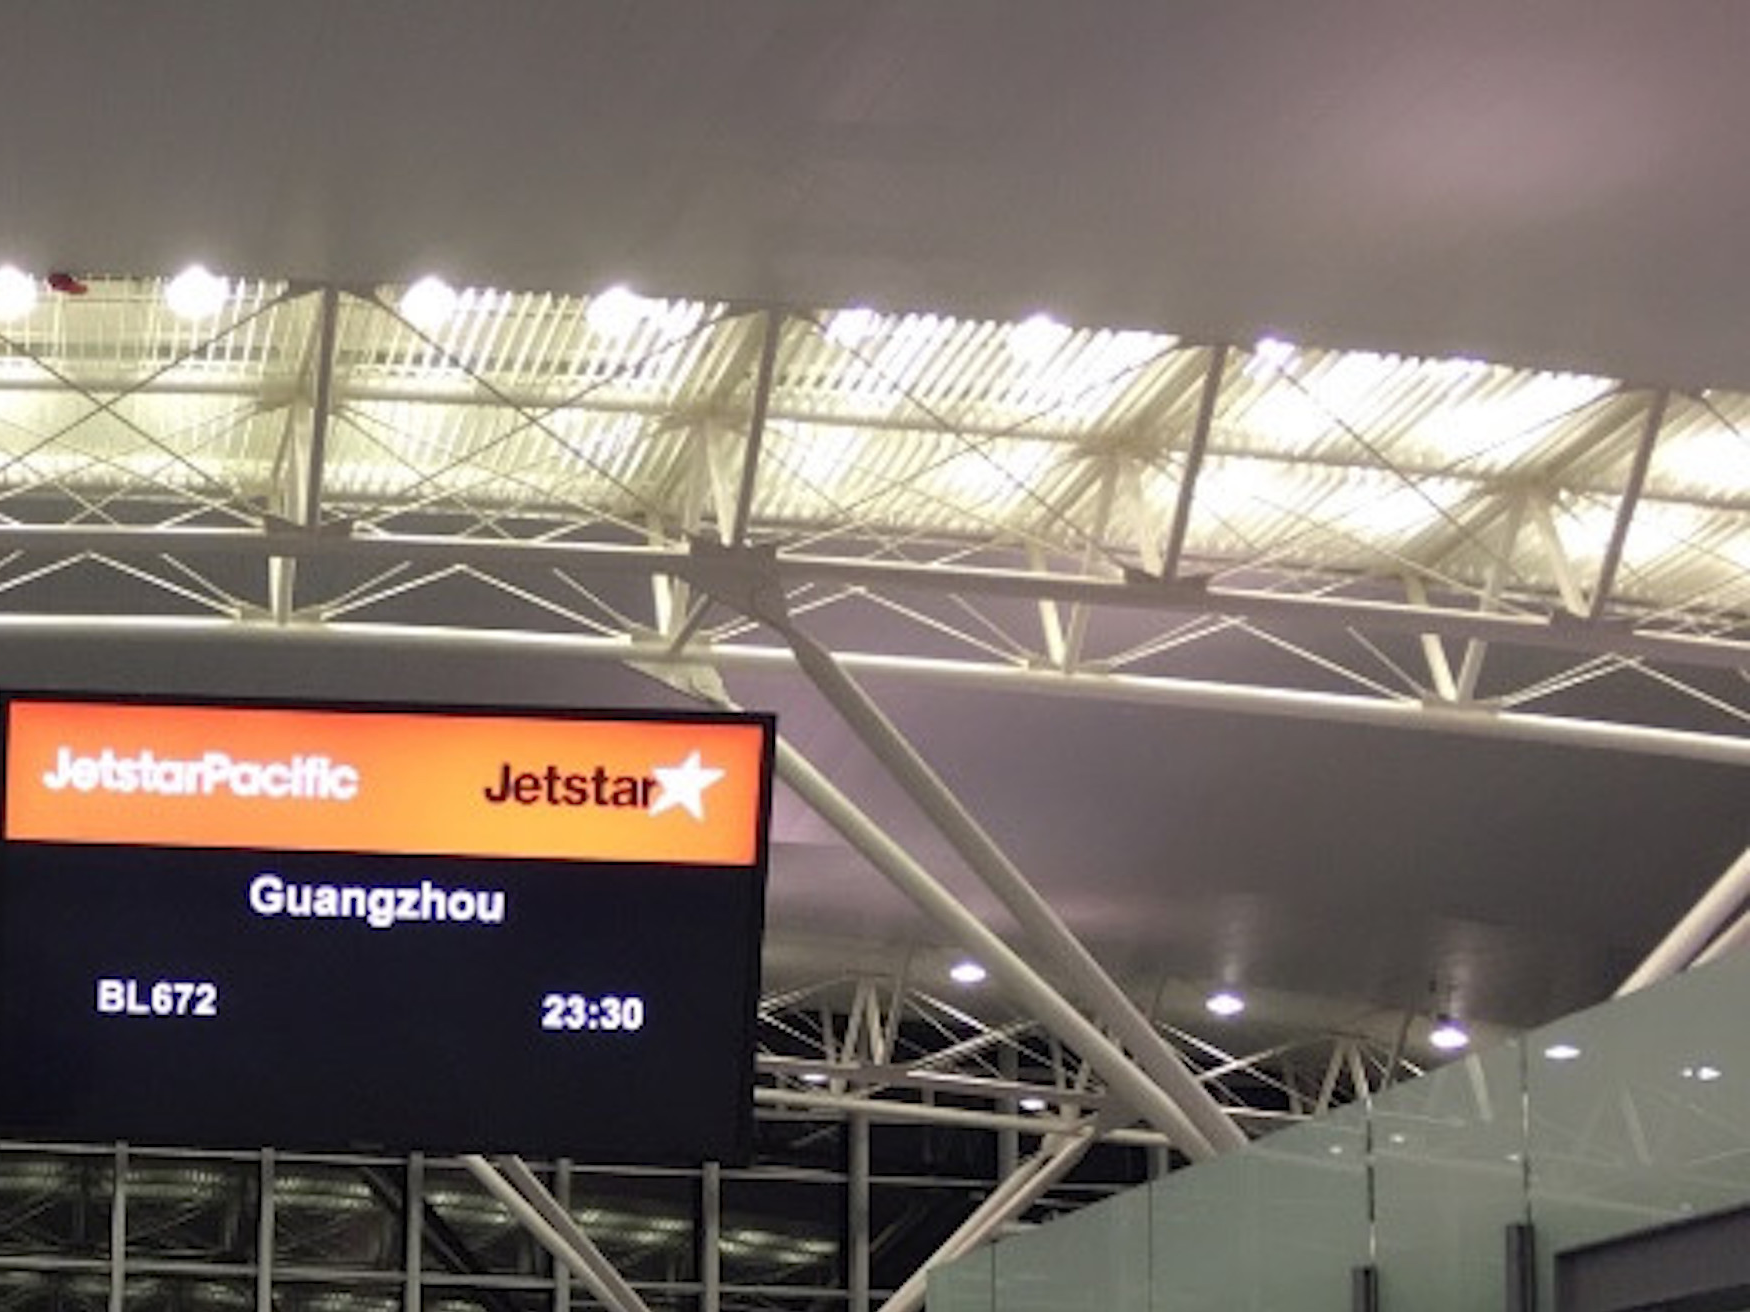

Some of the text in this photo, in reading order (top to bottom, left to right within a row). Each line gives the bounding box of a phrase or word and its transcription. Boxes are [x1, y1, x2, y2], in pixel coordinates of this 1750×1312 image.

[43, 747, 359, 801] JetstarPacific
[484, 763, 655, 808] Jetstar
[249, 876, 506, 928] Guangzhou
[97, 979, 217, 1016] BL672
[541, 995, 644, 1032] 23:30
